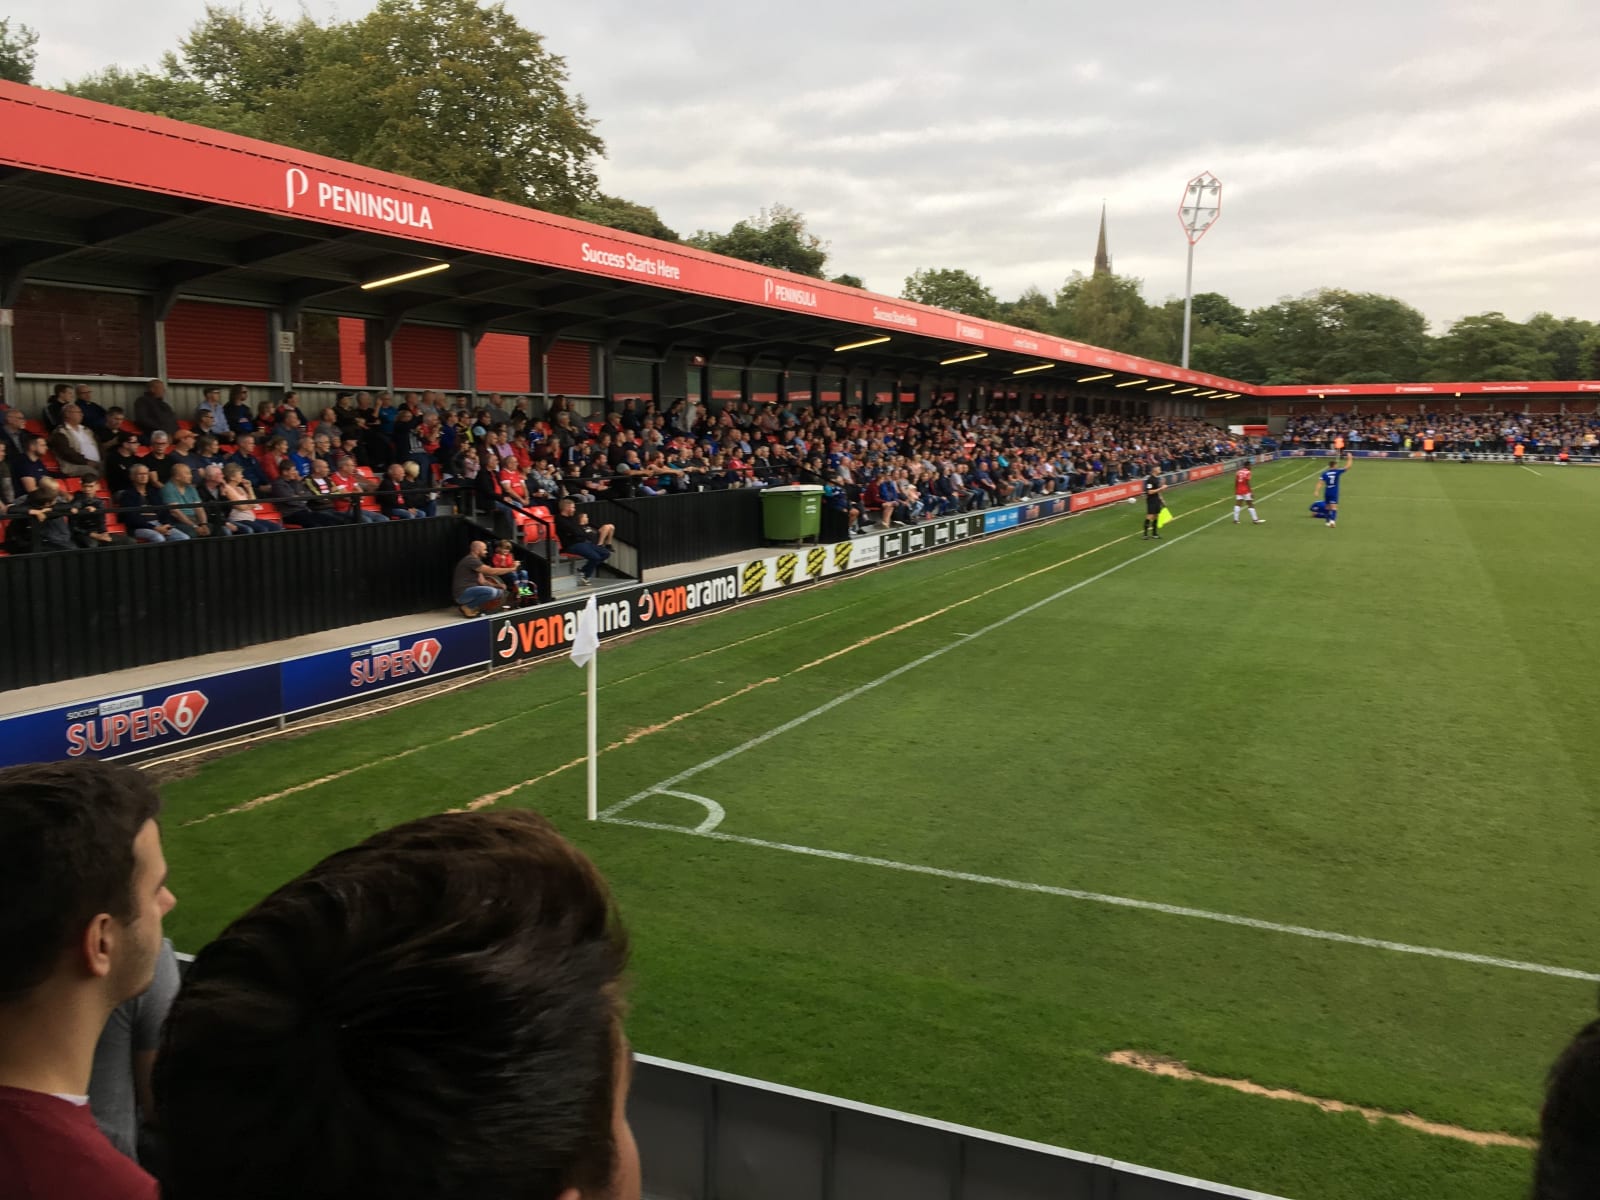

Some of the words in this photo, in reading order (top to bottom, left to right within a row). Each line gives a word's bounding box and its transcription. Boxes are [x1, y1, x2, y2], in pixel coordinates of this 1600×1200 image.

[318, 182, 433, 230] PENINSULA
[581, 242, 625, 269] Success
[626, 252, 656, 275] Starts
[656, 259, 680, 280] Here
[775, 285, 817, 307] PENINSULA
[653, 574, 735, 618] vanarama
[518, 599, 631, 653] vanarma
[350, 649, 416, 687] SUPER
[418, 642, 432, 668] 6
[66, 705, 168, 756] SUPER
[174, 695, 194, 728] 6
